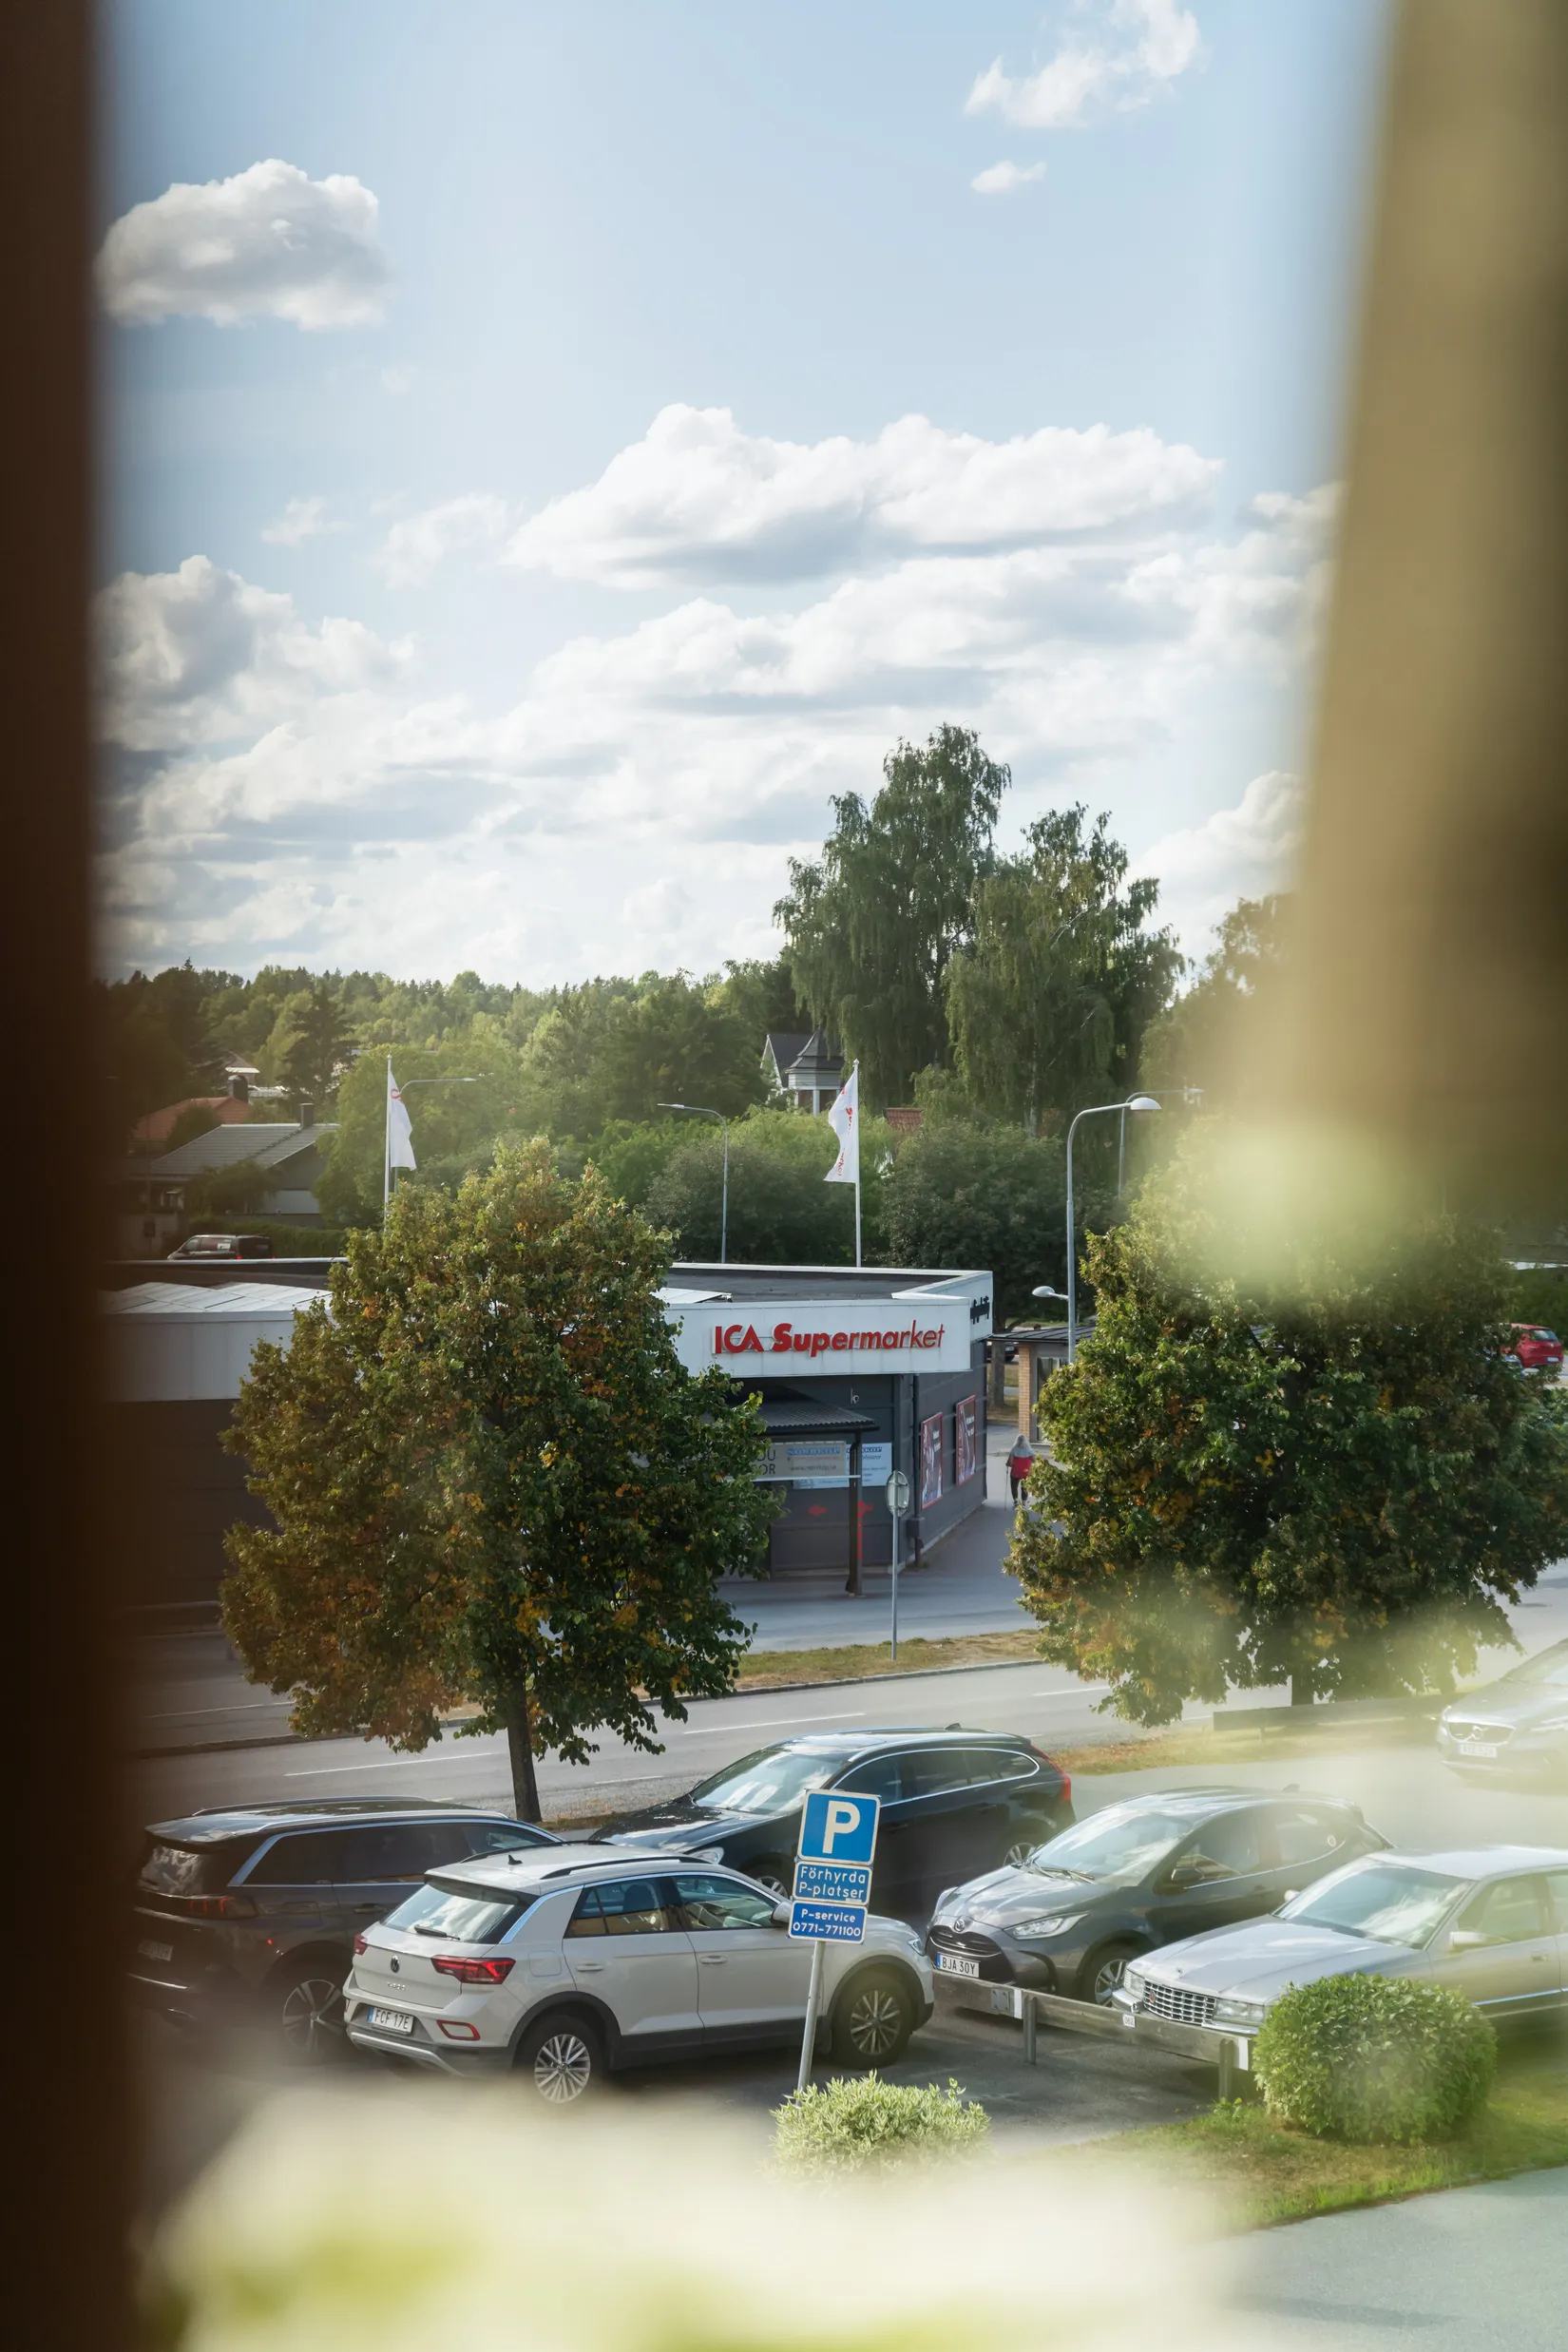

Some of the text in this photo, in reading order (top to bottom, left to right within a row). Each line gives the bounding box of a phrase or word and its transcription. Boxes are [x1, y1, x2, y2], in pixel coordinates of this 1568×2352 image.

[715, 1319, 945, 1357] ICA Supermarket
[822, 1800, 861, 1854] P
[800, 1866, 866, 1884] Förhyrda
[798, 1882, 864, 1899] P-platser
[801, 1908, 856, 1923] P-service
[793, 1922, 861, 1937] 0771-771100
[942, 1957, 975, 1975] BJA 30Y
[374, 2009, 392, 2024] FCF
